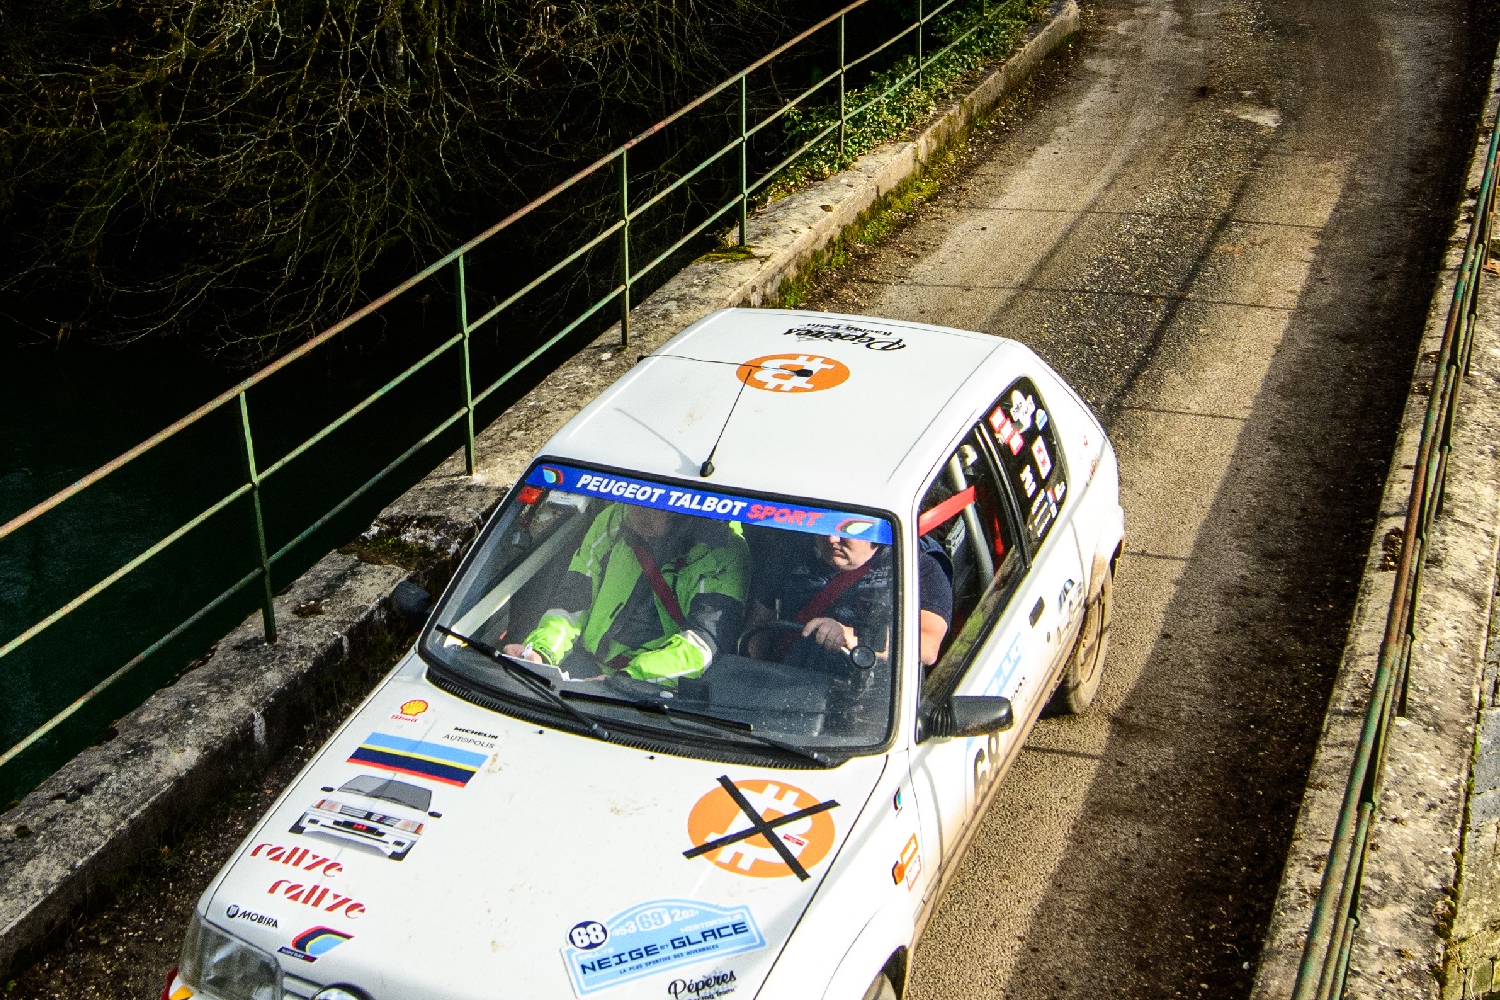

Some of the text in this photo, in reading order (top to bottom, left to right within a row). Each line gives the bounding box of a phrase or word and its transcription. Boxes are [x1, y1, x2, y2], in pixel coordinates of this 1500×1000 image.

[576, 474, 824, 527] PEUGEOT TALBOT SPORT
[390, 714, 418, 723] Shell
[441, 734, 496, 749] AUTOPOLIS
[453, 726, 499, 739] MICHELIN
[250, 843, 343, 878] rallye
[267, 880, 366, 919] rallye
[238, 910, 278, 929] MOBIRA
[571, 923, 606, 948] 68
[580, 944, 660, 975] NEIGE
[670, 921, 749, 950] GLACE
[668, 970, 737, 1000] Pépères
